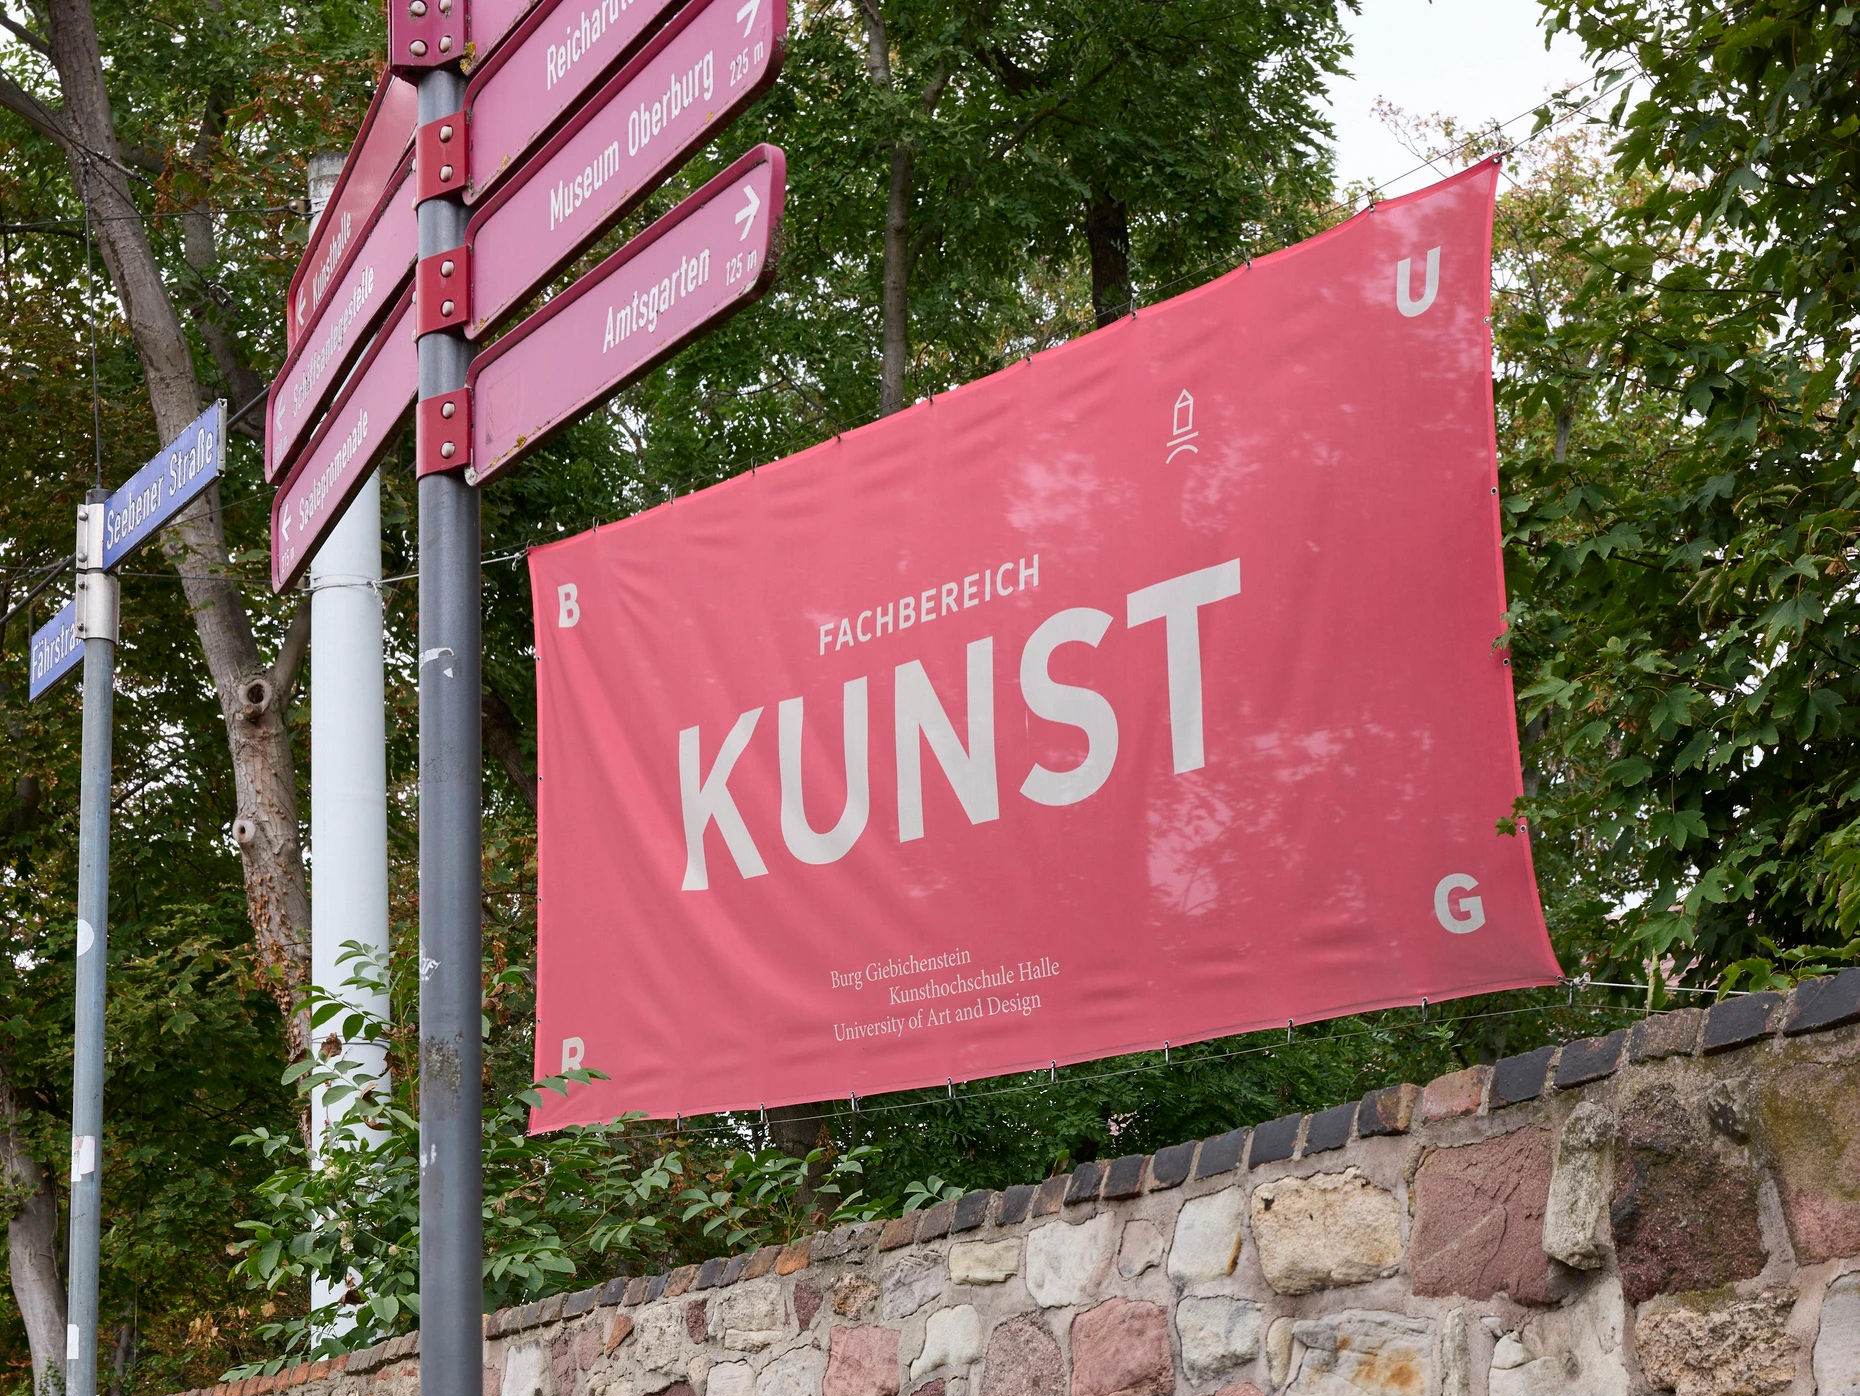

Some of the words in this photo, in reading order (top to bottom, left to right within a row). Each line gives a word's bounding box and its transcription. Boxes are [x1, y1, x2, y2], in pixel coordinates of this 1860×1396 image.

[547, 0, 636, 91] Reichar
[730, 48, 749, 87] 225
[754, 40, 764, 65] m
[549, 140, 619, 231] Museum
[628, 50, 714, 157] Oberburg
[312, 211, 352, 311] Kunsthalle
[726, 252, 743, 286] 125
[747, 249, 757, 273] m
[1396, 246, 1441, 318] U
[602, 248, 710, 354] Amtsgarten
[292, 265, 374, 417] Schiffsanlegestelle
[106, 474, 165, 550] Seebener
[169, 427, 214, 497] Straße
[299, 408, 368, 532] Saalepromenade
[557, 582, 581, 628] B
[818, 553, 1040, 656] FACHBEREICH
[31, 622, 83, 684] Fährstra
[678, 557, 1242, 892] KUNST
[1434, 873, 1485, 935] G
[830, 968, 863, 990] Burg
[866, 948, 972, 982] Giebichenstein
[889, 965, 1015, 1005] Kunsthochschule
[1018, 957, 1060, 982] Halle
[833, 1015, 905, 1042] University
[908, 1009, 924, 1030] of
[927, 1008, 951, 1027] Art
[955, 999, 984, 1022] and
[987, 992, 1042, 1017] Design
[561, 1036, 585, 1083] R
